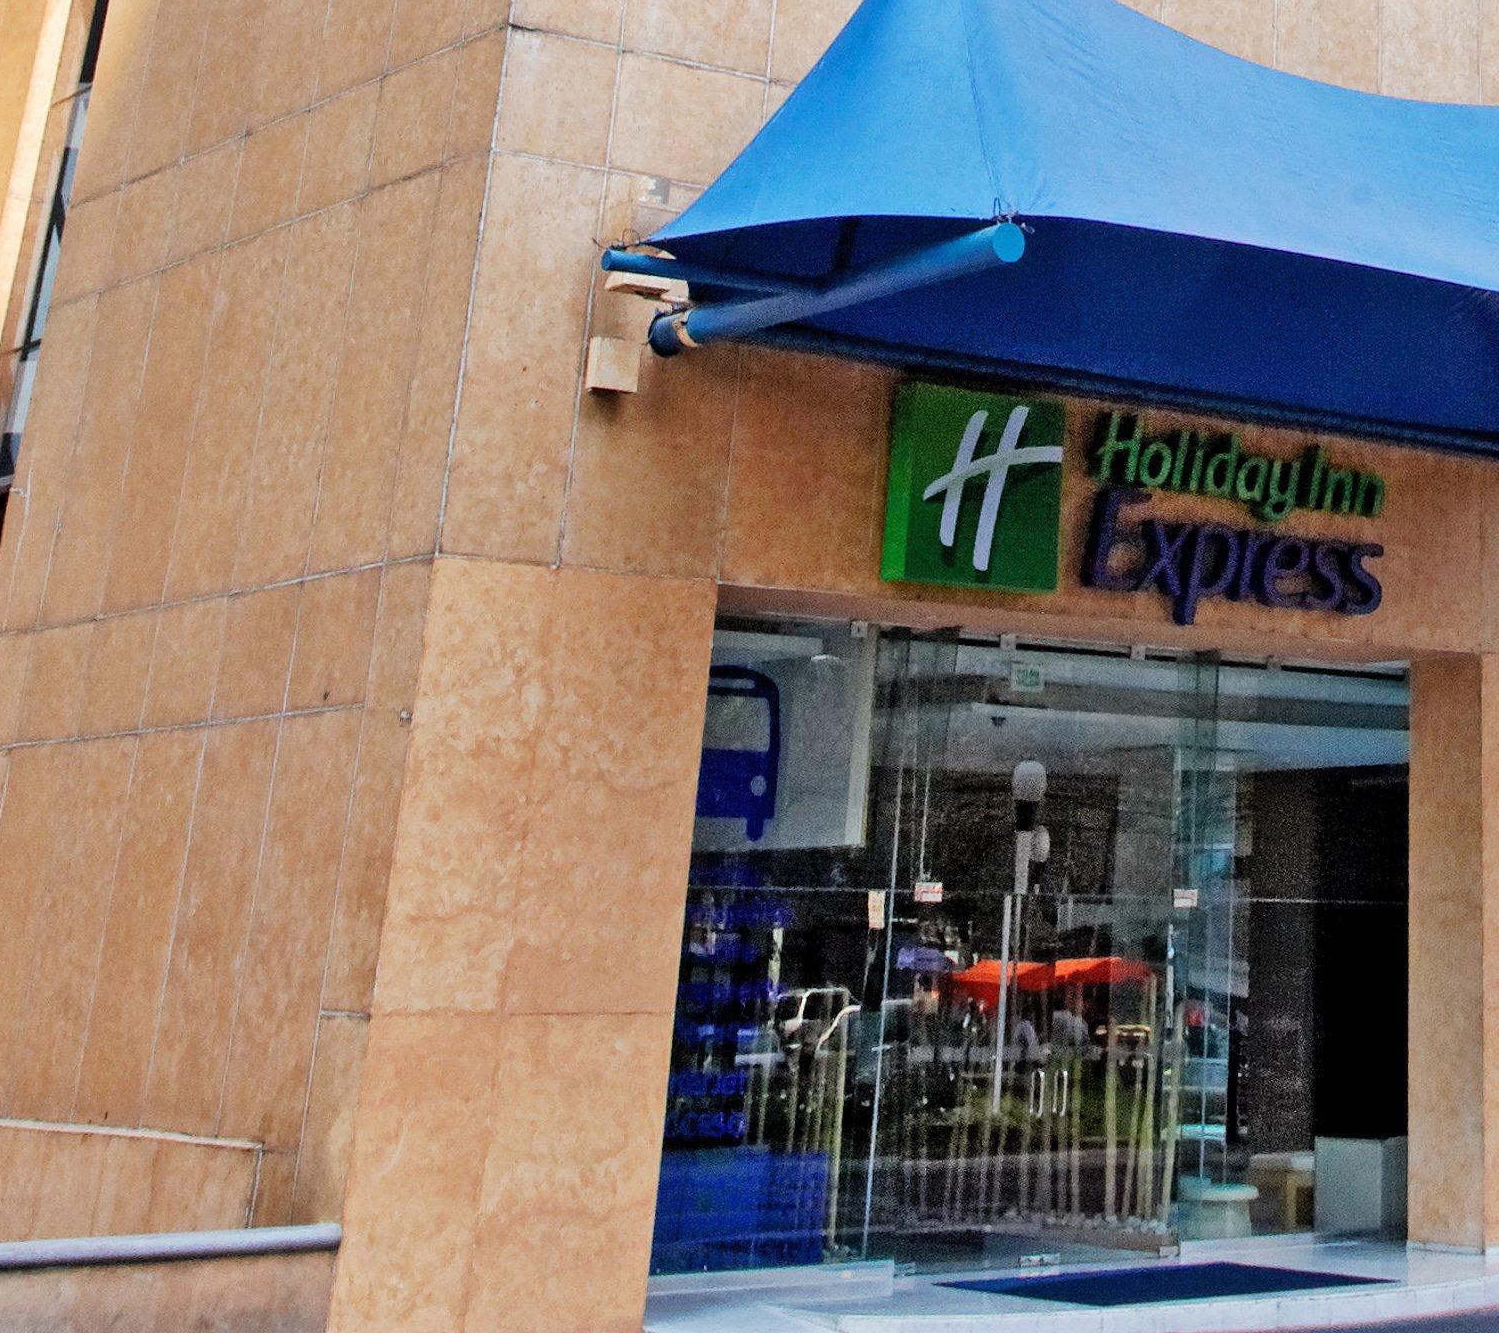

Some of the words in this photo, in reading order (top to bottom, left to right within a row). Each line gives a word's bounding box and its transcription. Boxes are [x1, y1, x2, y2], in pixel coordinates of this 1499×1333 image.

[1095, 410, 1300, 522] Holiday
[1307, 443, 1386, 518] Inn
[1084, 488, 1385, 625] Express
